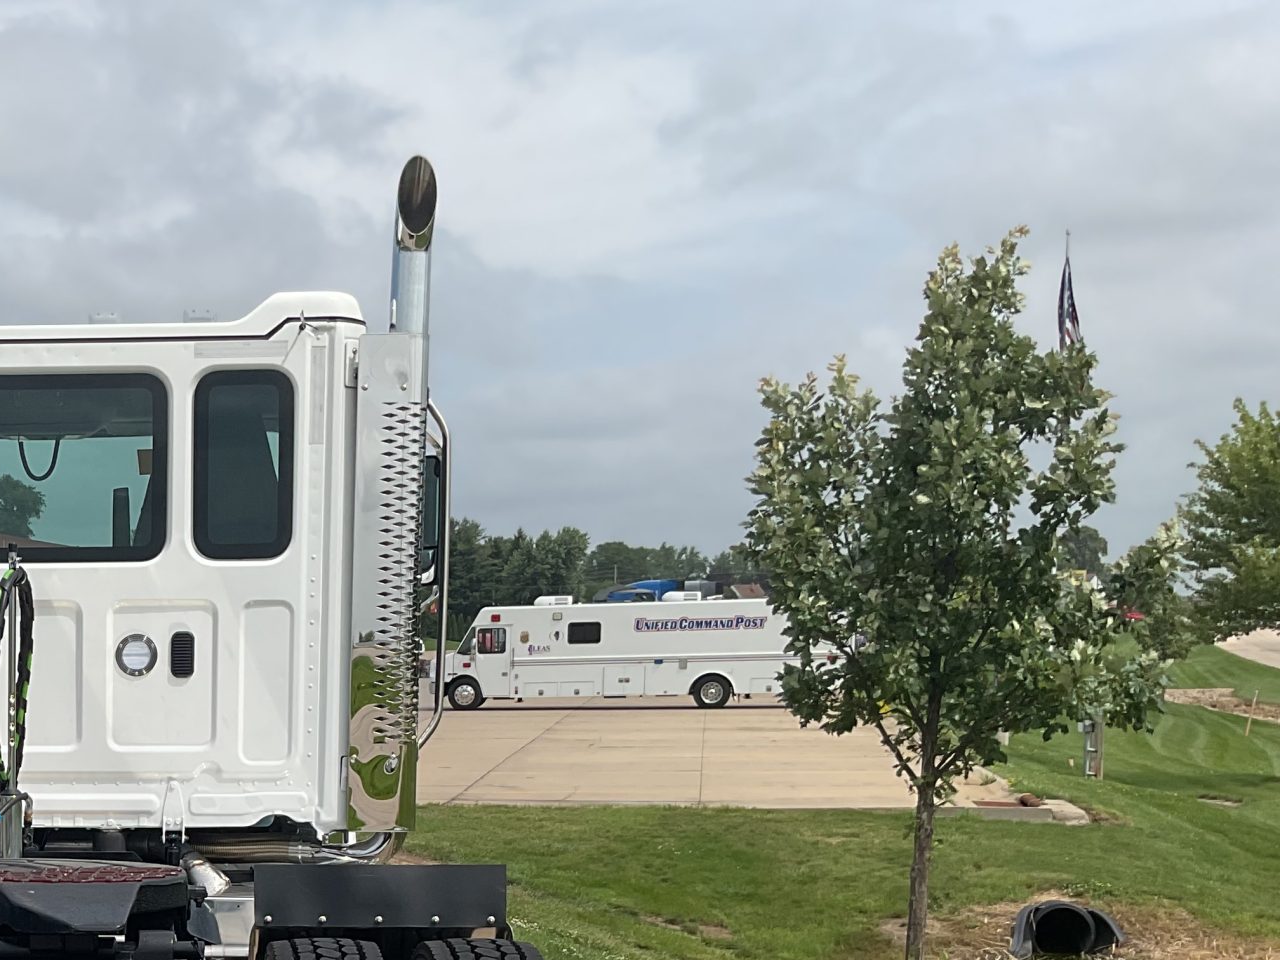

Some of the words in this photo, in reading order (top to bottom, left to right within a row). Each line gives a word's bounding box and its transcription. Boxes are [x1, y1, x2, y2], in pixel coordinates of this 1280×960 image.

[634, 618, 678, 631] UNIFIED
[679, 617, 734, 630] COMMAND
[735, 615, 767, 629] POST
